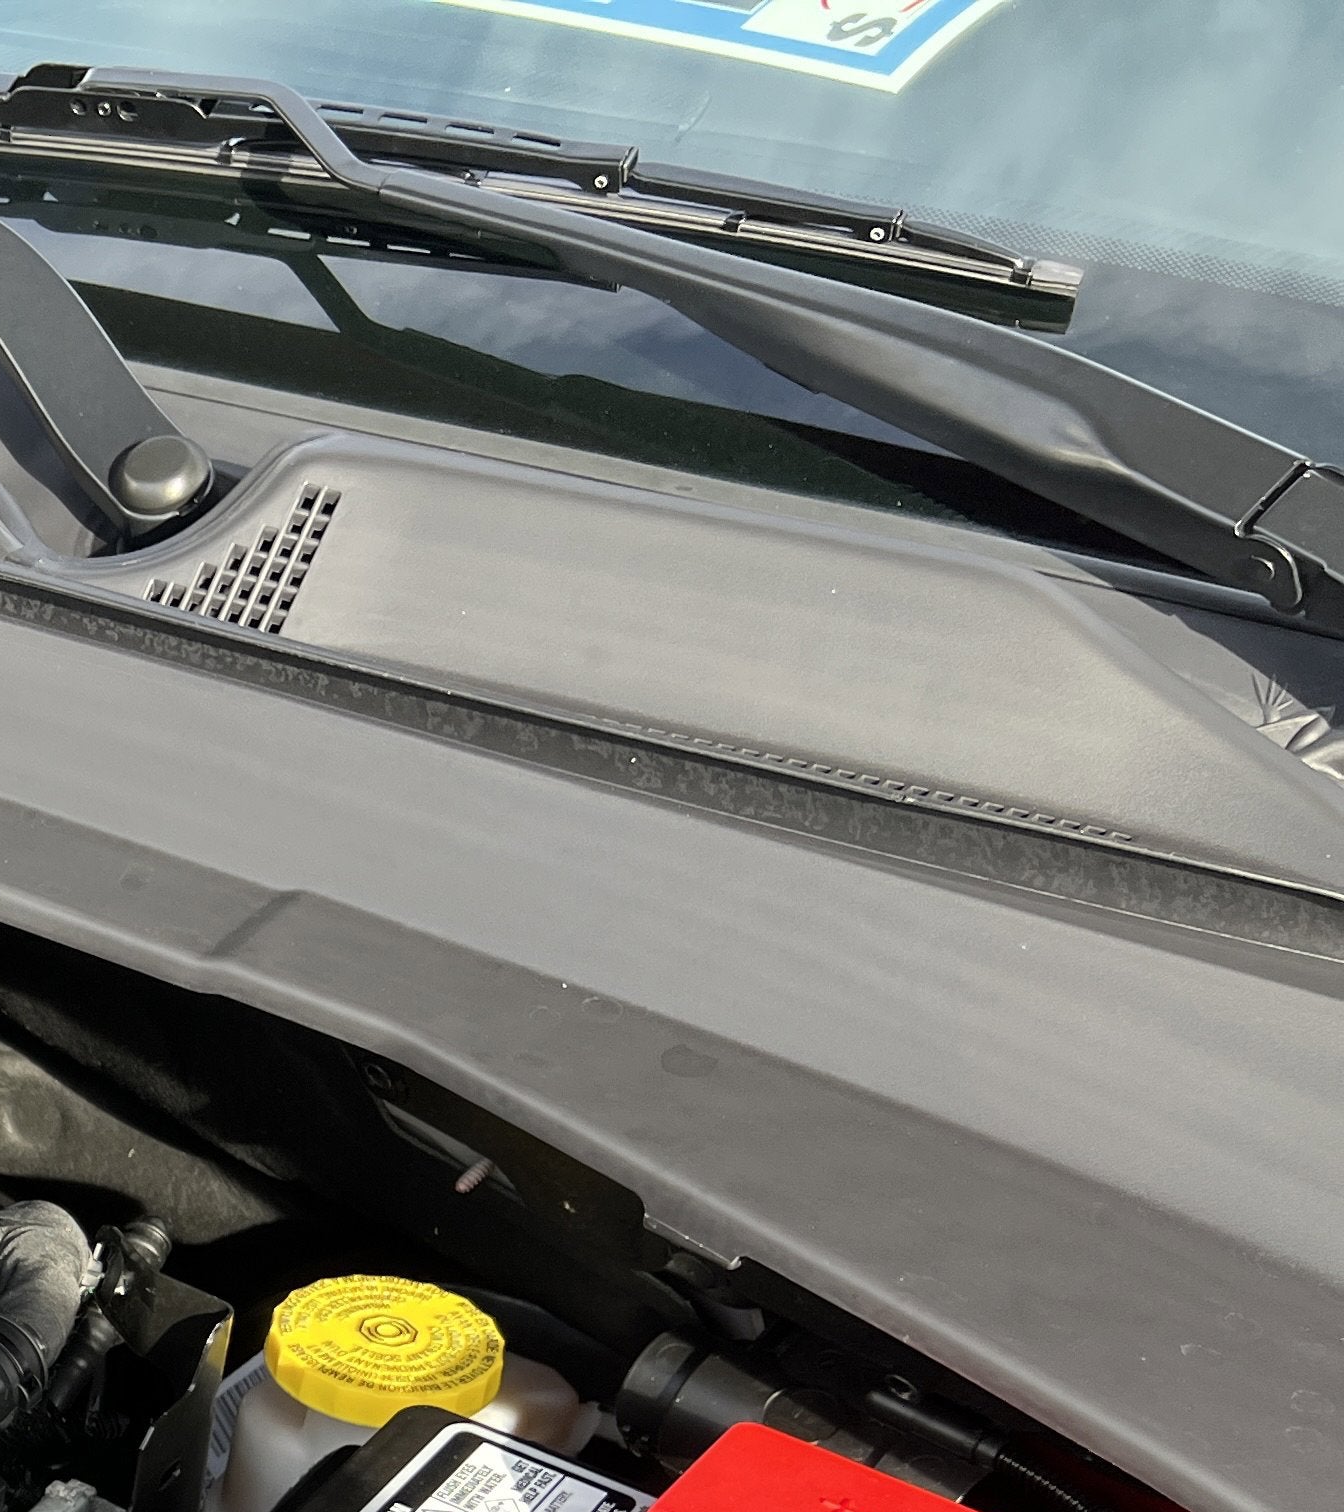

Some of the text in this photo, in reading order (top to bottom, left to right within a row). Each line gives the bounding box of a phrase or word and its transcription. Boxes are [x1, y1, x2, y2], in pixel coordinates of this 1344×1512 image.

[510, 1459, 531, 1473] GET
[435, 1462, 478, 1499] FLUSH EYES
[509, 1464, 545, 1493] MEDICAL
[461, 1493, 485, 1510] WITH
[517, 1486, 542, 1504] HELP
